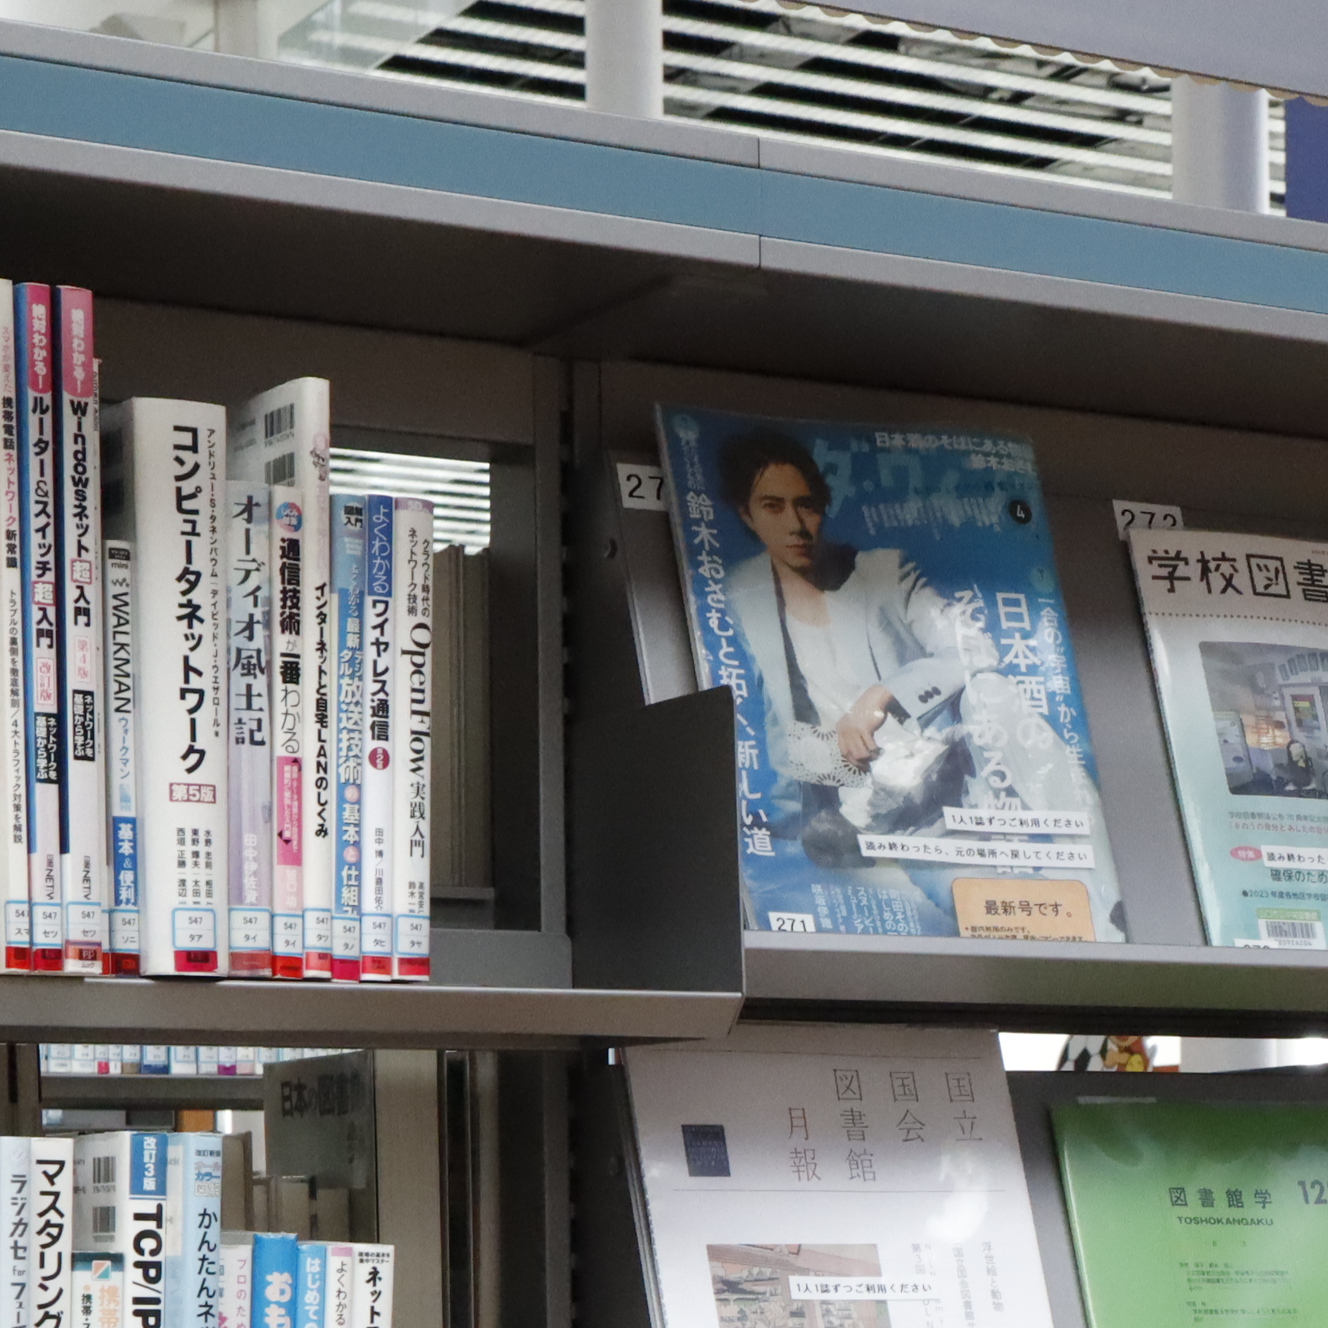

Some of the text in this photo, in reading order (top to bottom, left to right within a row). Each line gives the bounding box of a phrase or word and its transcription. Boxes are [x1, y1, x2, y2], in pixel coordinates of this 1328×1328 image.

[626, 474, 664, 500] 27
[172, 425, 207, 775] コンピュータネットワーク
[407, 528, 418, 617] ネットワーク技術
[421, 539, 430, 618] クラウド時代の
[112, 592, 131, 713] WALKMAN
[232, 495, 266, 746] オーディオ風土記
[279, 538, 301, 754] 通信技術が一番わかる
[38, 660, 53, 703] 改訂版
[75, 637, 89, 681] 第4版
[370, 600, 389, 742] ワイヤレス通信
[315, 583, 328, 838] インターネットと自宅LANのしくみ
[401, 622, 431, 859] OpenFlow実践入門
[117, 717, 131, 779] ウォークマン
[171, 784, 215, 803] 第5版
[952, 813, 1085, 831] 1人1誌ずつご利用ください
[864, 839, 1089, 862] 読み終わったら、元の場所へ戻してください
[188, 916, 203, 925] 547
[775, 917, 806, 931] 271
[984, 899, 1073, 918] 最新号です。
[833, 1068, 877, 1182] 図書館
[889, 1070, 926, 1143] 国会
[944, 1072, 983, 1142] 国立
[143, 1136, 157, 1190] 改訂3版
[788, 1107, 821, 1182] 月報
[10, 1174, 28, 1260] ラジカセ
[1168, 1186, 1273, 1209] 図書館学
[1177, 1216, 1274, 1226] TOSHOKANGAKU
[795, 1282, 932, 1295] 1人1誌ずつご利用ください
